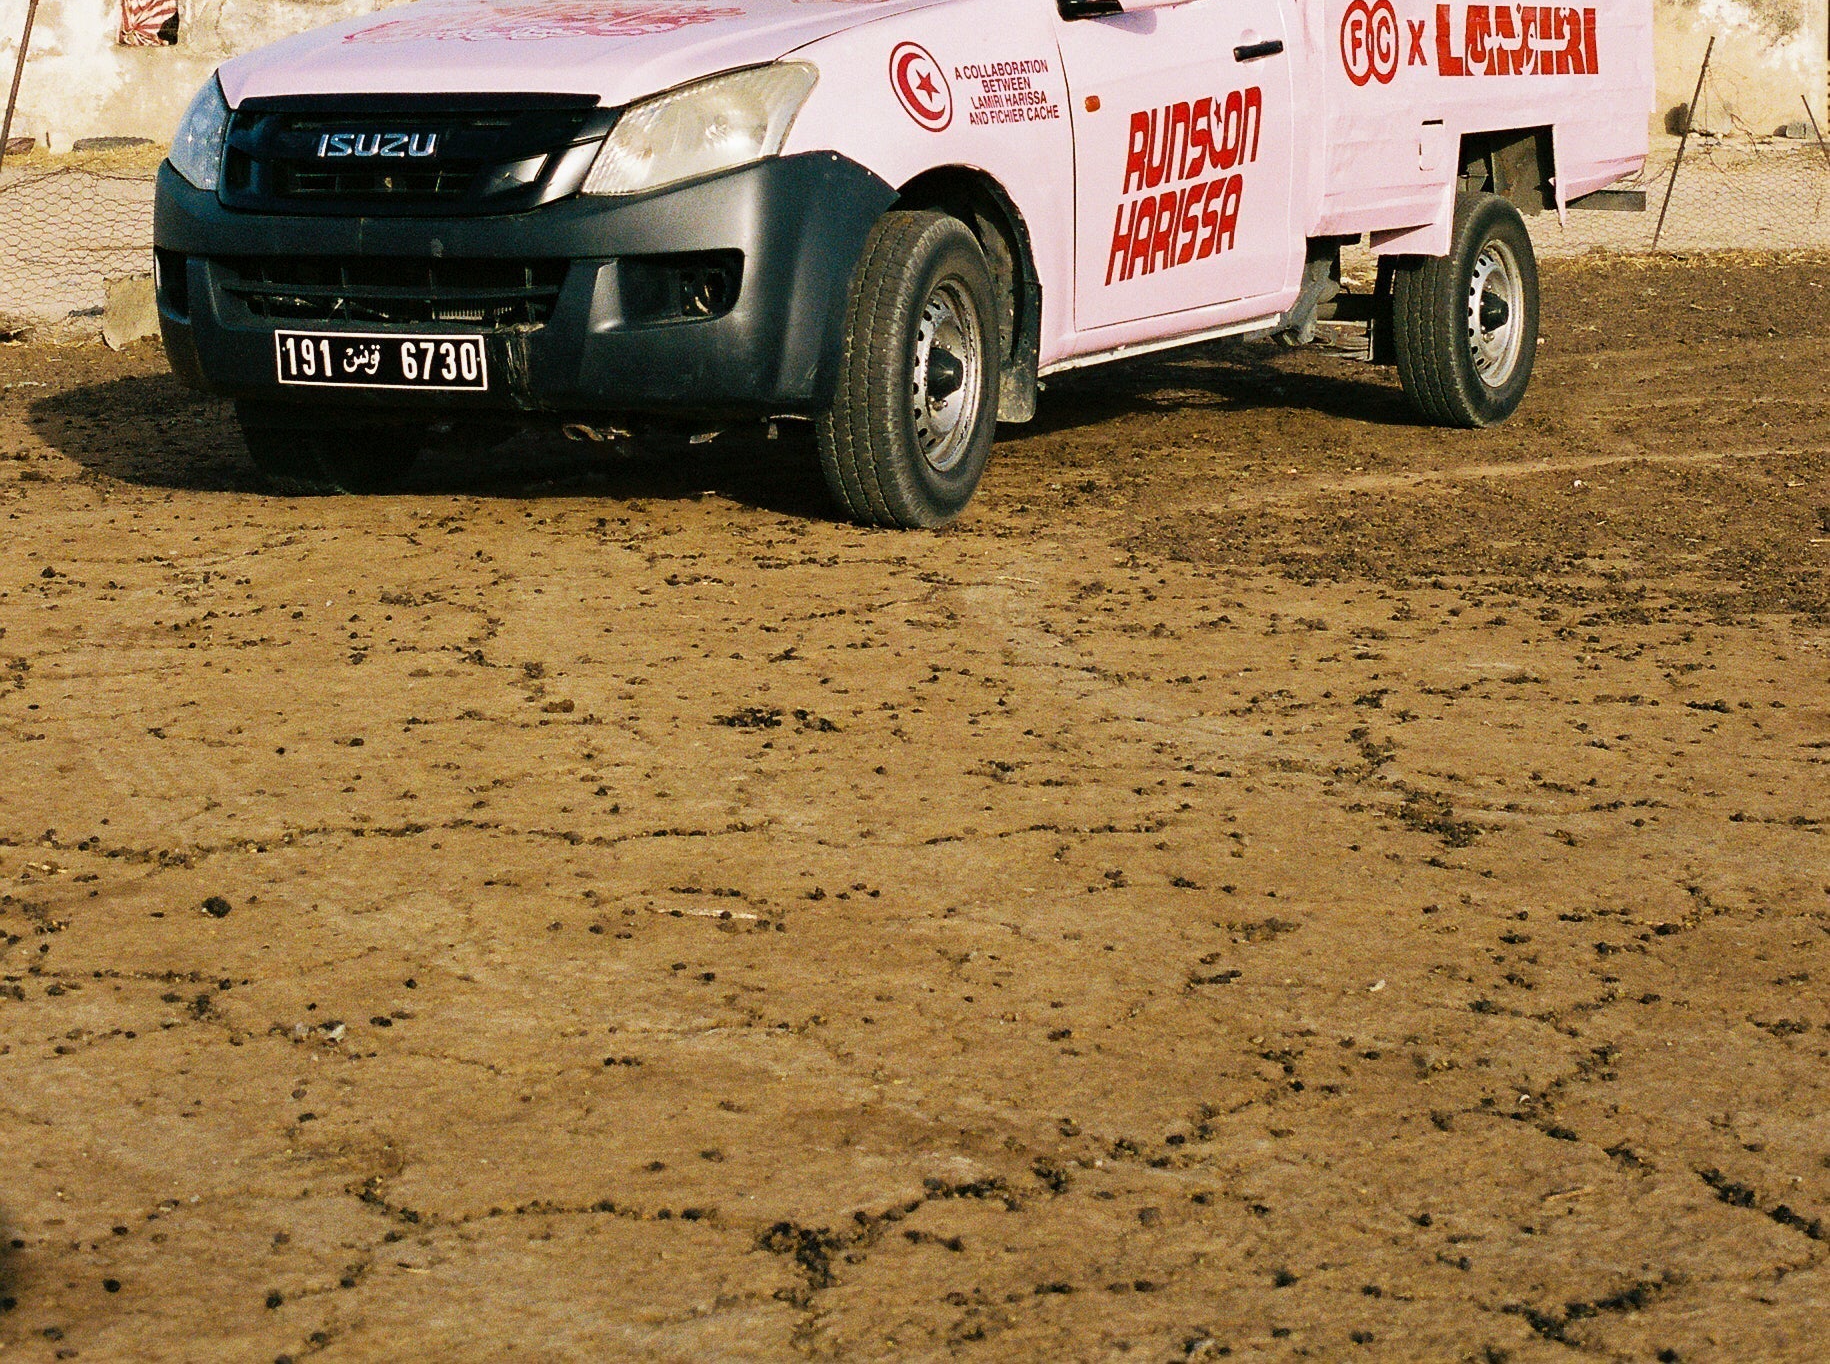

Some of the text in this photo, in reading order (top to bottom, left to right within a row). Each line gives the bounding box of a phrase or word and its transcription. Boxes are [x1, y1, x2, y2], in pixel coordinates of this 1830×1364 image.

[1435, 3, 1599, 77] LAMIRI
[954, 59, 1049, 81] A COLLABORATION
[981, 76, 1032, 94] BETWEEN
[970, 90, 1048, 110] LAMIRI HARISSA
[968, 104, 1060, 126] AND FICHIER CACHE
[317, 133, 437, 158] ISUZU
[1104, 173, 1244, 287] HARISSA
[285, 337, 478, 381] 191 تونس 6730
